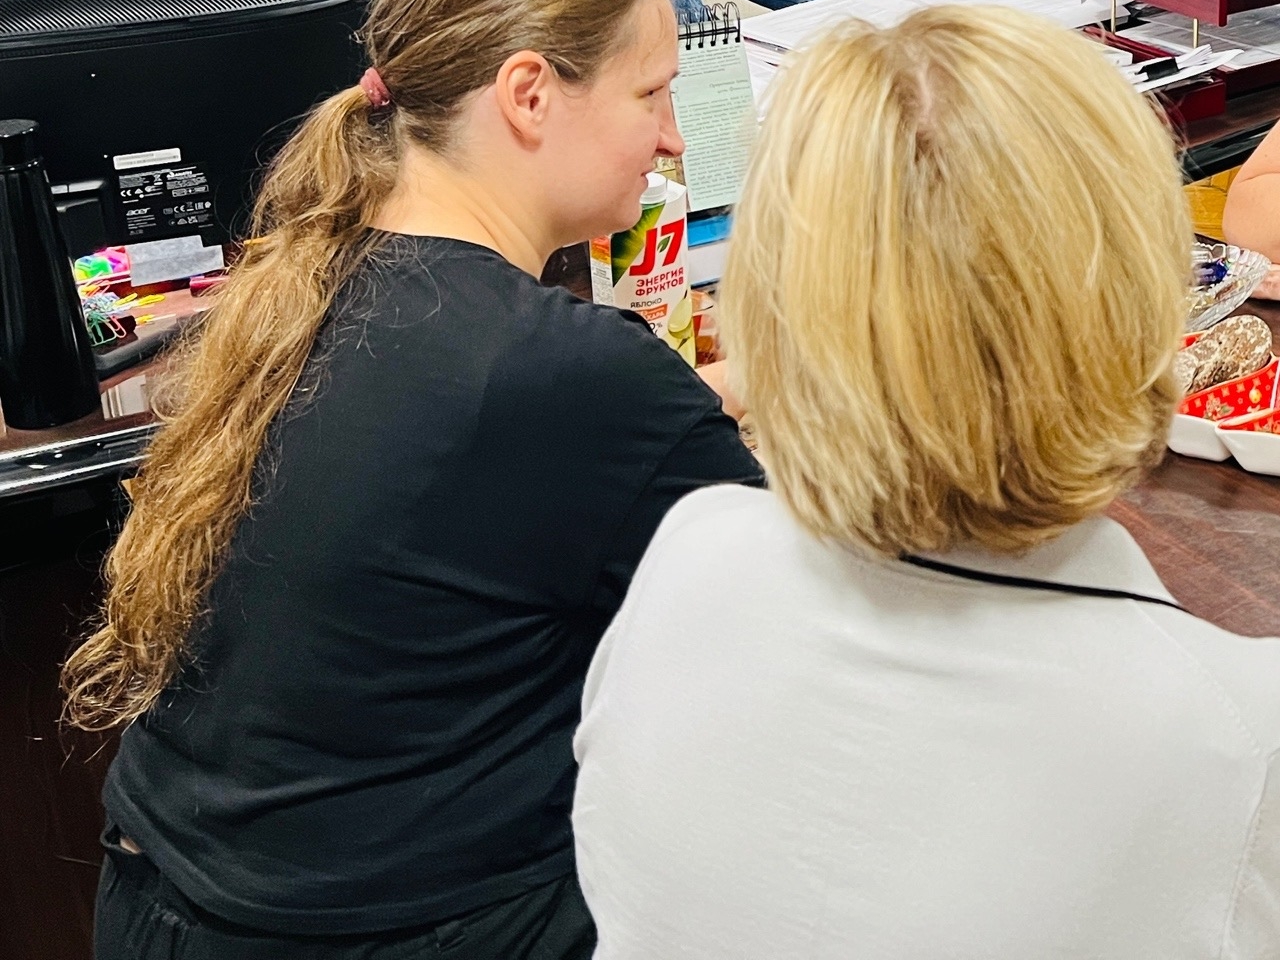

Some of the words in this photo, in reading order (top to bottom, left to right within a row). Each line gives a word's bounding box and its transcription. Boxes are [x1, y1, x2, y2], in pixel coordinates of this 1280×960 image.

[629, 217, 685, 276] J7
[635, 277, 684, 296] ФРУКТОВ
[636, 267, 684, 288] ЭНЕРГИЯ
[630, 298, 662, 308] ЯБЛОКО
